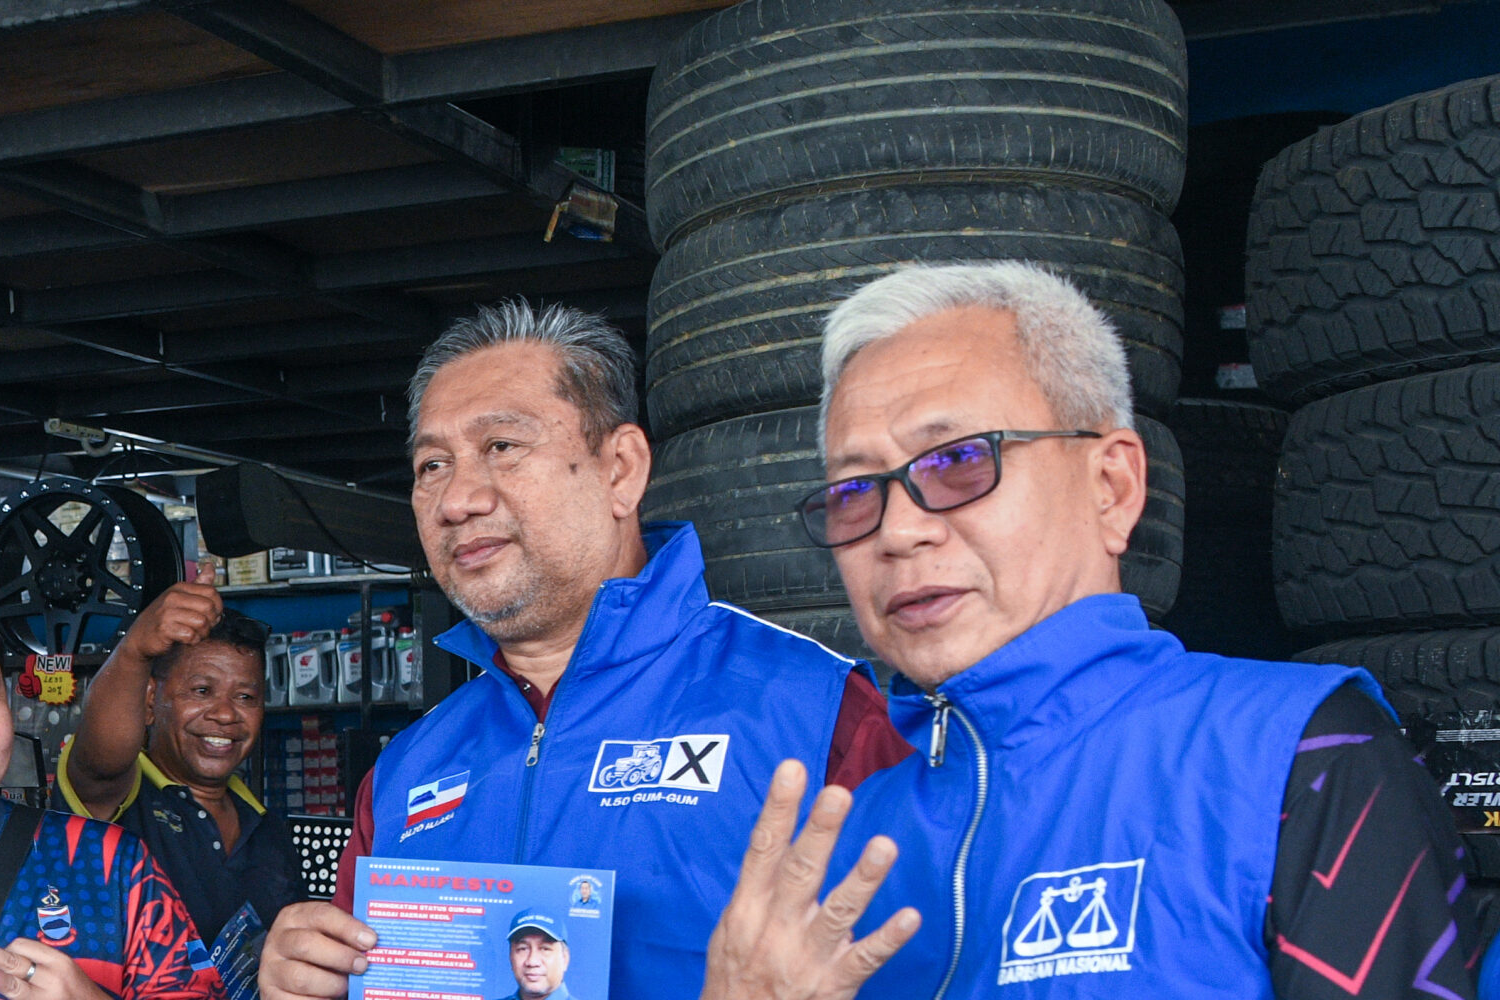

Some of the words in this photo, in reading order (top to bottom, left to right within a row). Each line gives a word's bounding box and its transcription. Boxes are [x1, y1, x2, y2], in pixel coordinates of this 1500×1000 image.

[37, 656, 72, 672] NEW!
[632, 791, 699, 805] GUM-GUM
[369, 872, 514, 893] MANIFESTO
[996, 960, 1055, 986] BARISAN
[1054, 953, 1132, 976] NASIONAL
